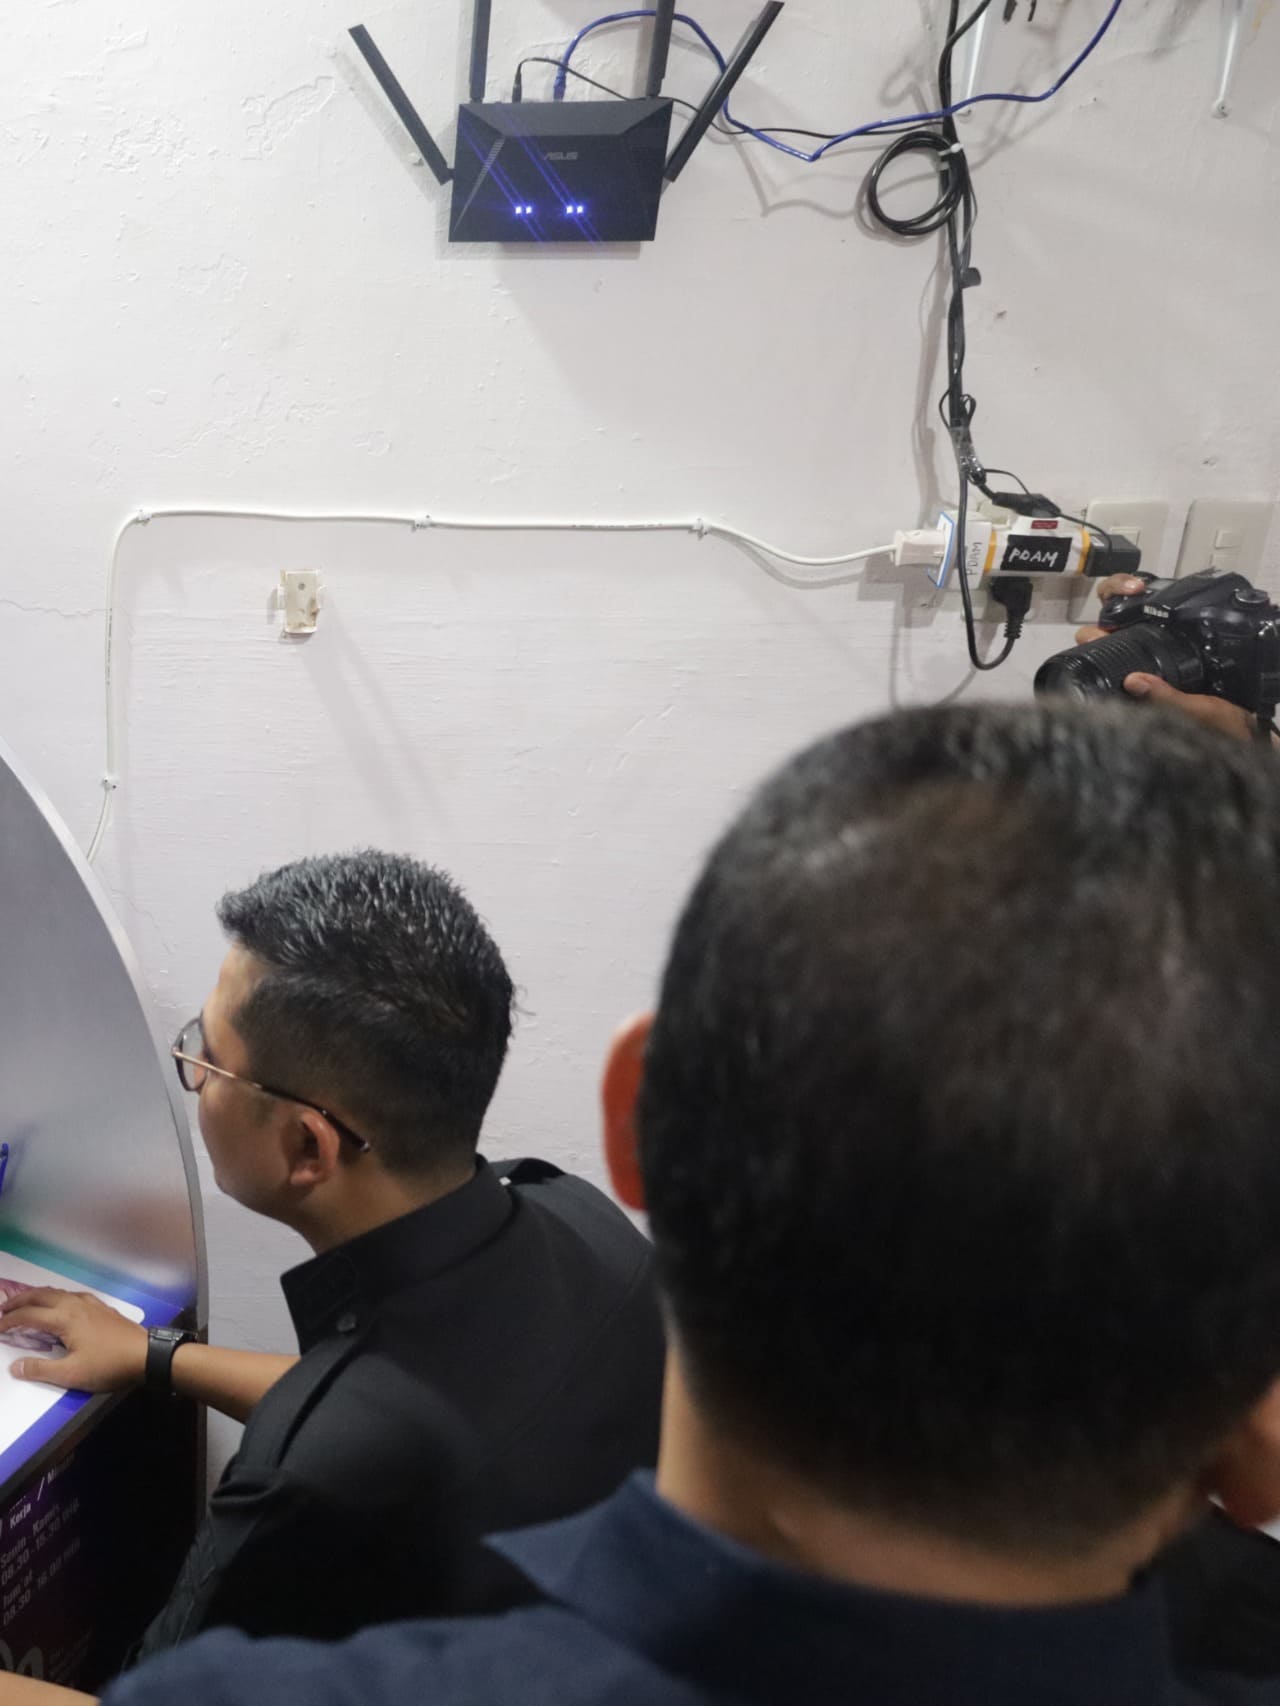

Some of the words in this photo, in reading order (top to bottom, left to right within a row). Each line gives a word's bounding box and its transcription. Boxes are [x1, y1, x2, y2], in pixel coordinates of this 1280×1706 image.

[543, 151, 579, 161] ASUS
[1008, 547, 1059, 567] PDAM
[1143, 605, 1169, 619] Nikon
[10, 1502, 31, 1529] Kerja
